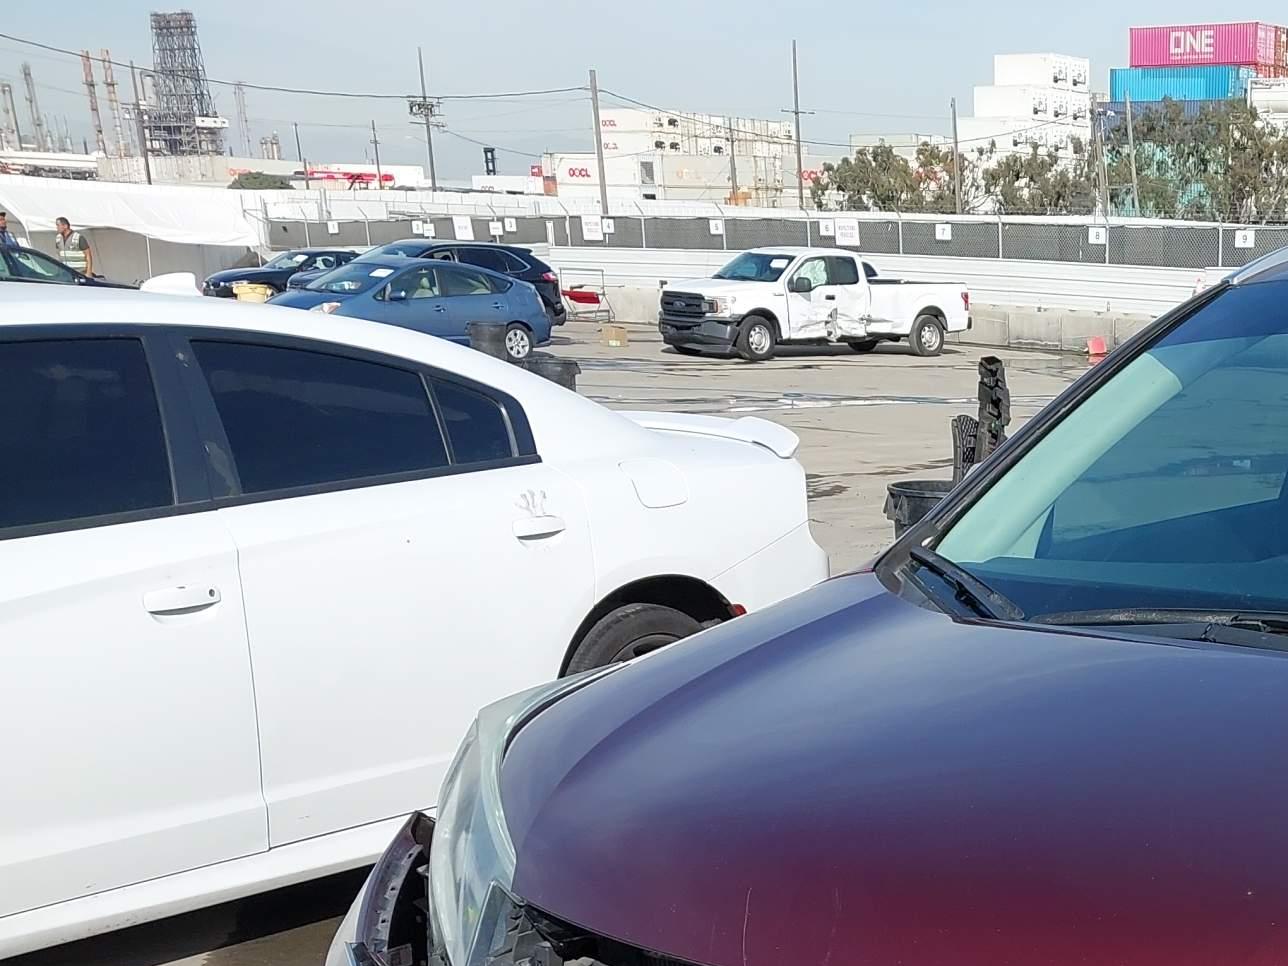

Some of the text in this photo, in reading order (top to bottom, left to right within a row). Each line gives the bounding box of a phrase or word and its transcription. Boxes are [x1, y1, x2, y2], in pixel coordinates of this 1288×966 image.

[1169, 30, 1214, 54] ONE
[568, 167, 591, 178] OOCL
[1242, 234, 1248, 243] 9
